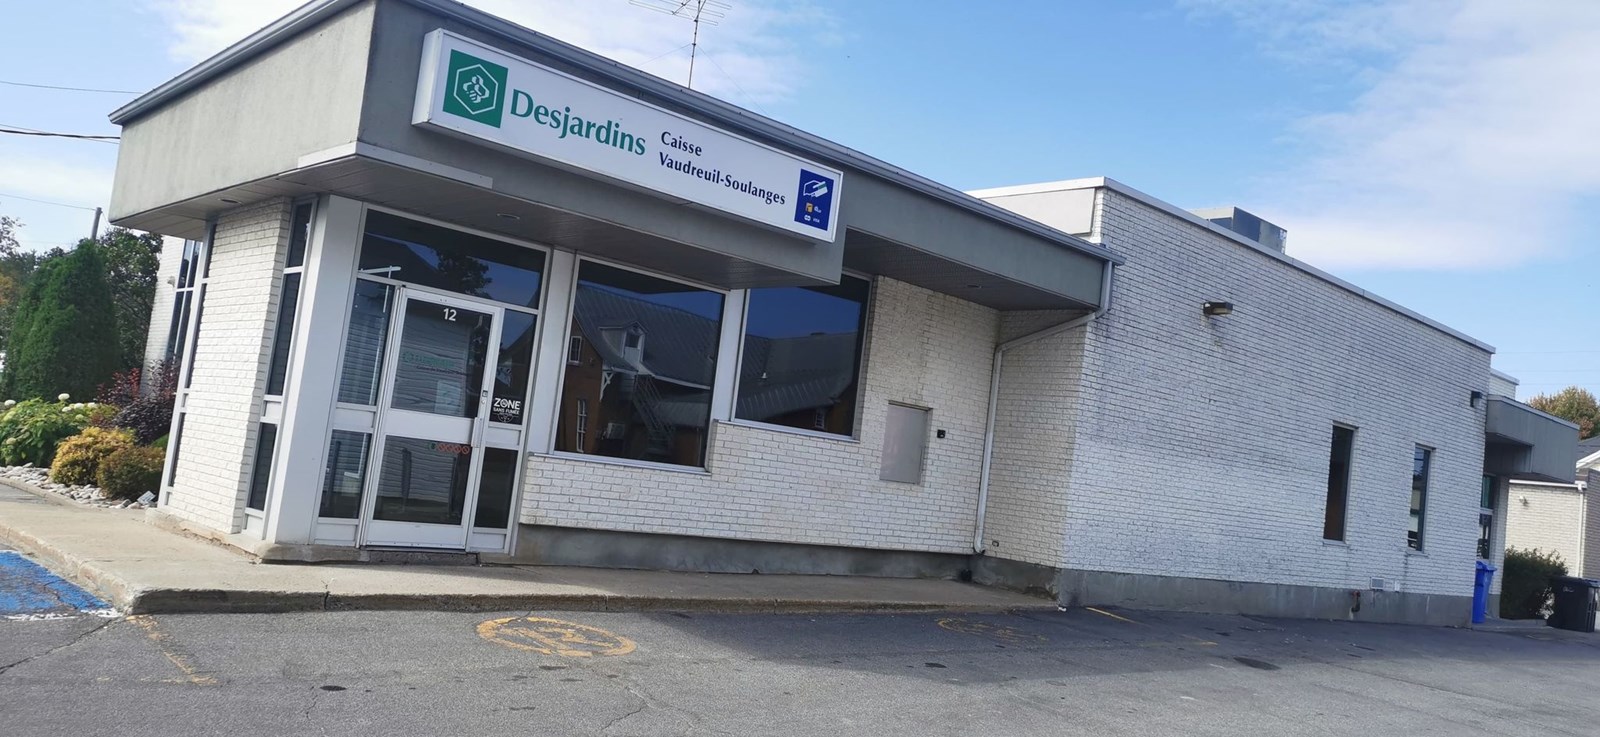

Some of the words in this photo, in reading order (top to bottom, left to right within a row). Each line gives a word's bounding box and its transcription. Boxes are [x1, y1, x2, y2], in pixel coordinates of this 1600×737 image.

[510, 88, 646, 156] Desjardins
[660, 131, 702, 157] Caisse
[659, 151, 786, 205] Vaudreuil-Soulanges
[443, 308, 457, 321] 12
[493, 397, 521, 410] ZONE
